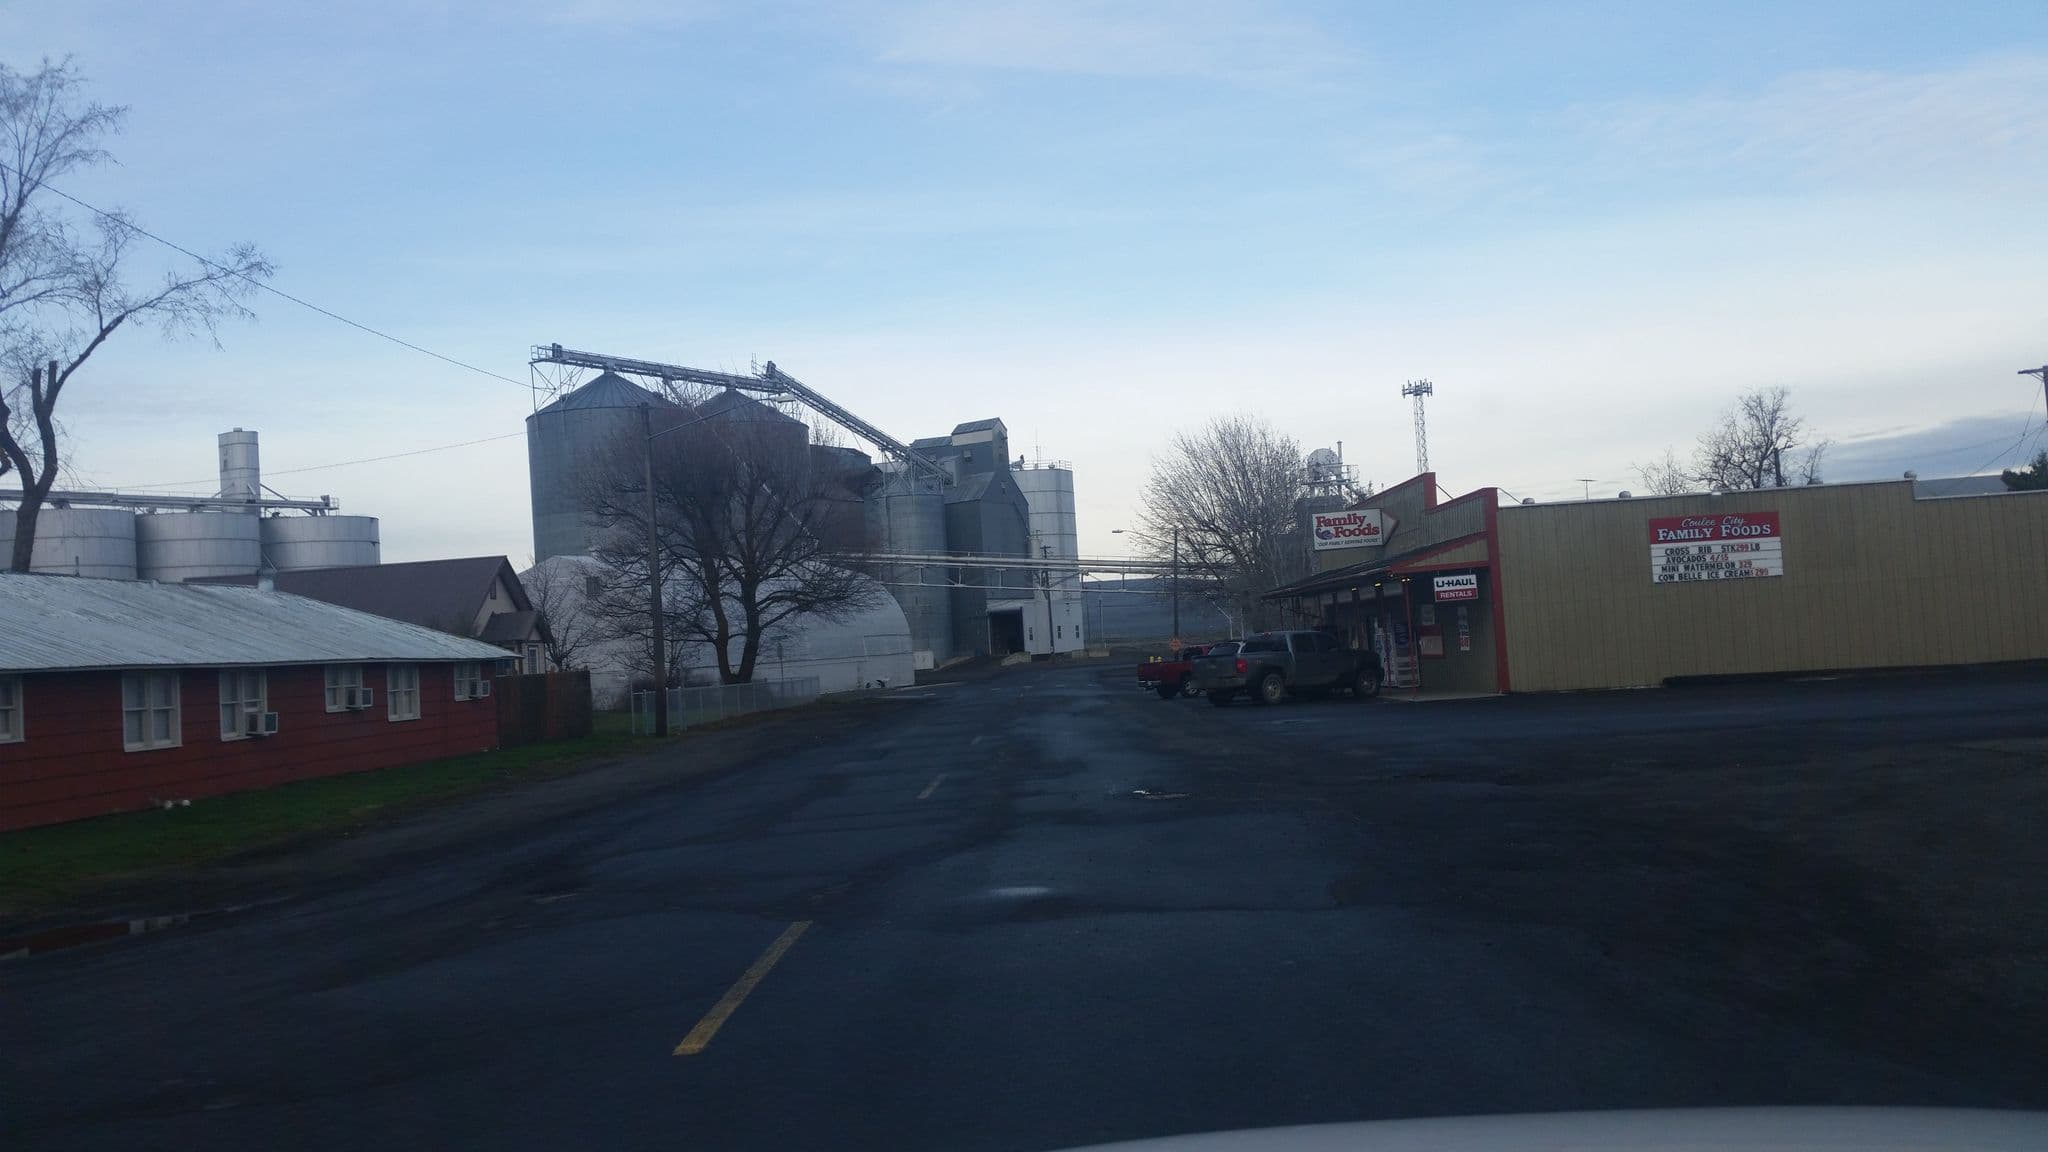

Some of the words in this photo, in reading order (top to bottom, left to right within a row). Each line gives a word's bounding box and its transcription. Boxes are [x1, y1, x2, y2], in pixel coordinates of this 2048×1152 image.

[1315, 513, 1367, 527] Family
[1681, 517, 1716, 527] Coulee
[1722, 515, 1745, 526] City
[1333, 523, 1380, 538] Foods
[1657, 528, 1713, 541] FAMILY
[1721, 524, 1771, 537] FOODS
[1665, 547, 1690, 557] CROSS
[1698, 545, 1712, 554] RIB
[1750, 543, 1760, 552] LB
[1666, 554, 1706, 564] AVOCADOS
[1661, 564, 1680, 573] MINI
[1684, 561, 1736, 571] WATERMELON
[1658, 573, 1675, 581] COW
[1678, 571, 1703, 580] BELLE
[1707, 570, 1720, 579] ICE
[1436, 578, 1475, 588] U-HAUL
[1440, 590, 1473, 599] RENTALS
